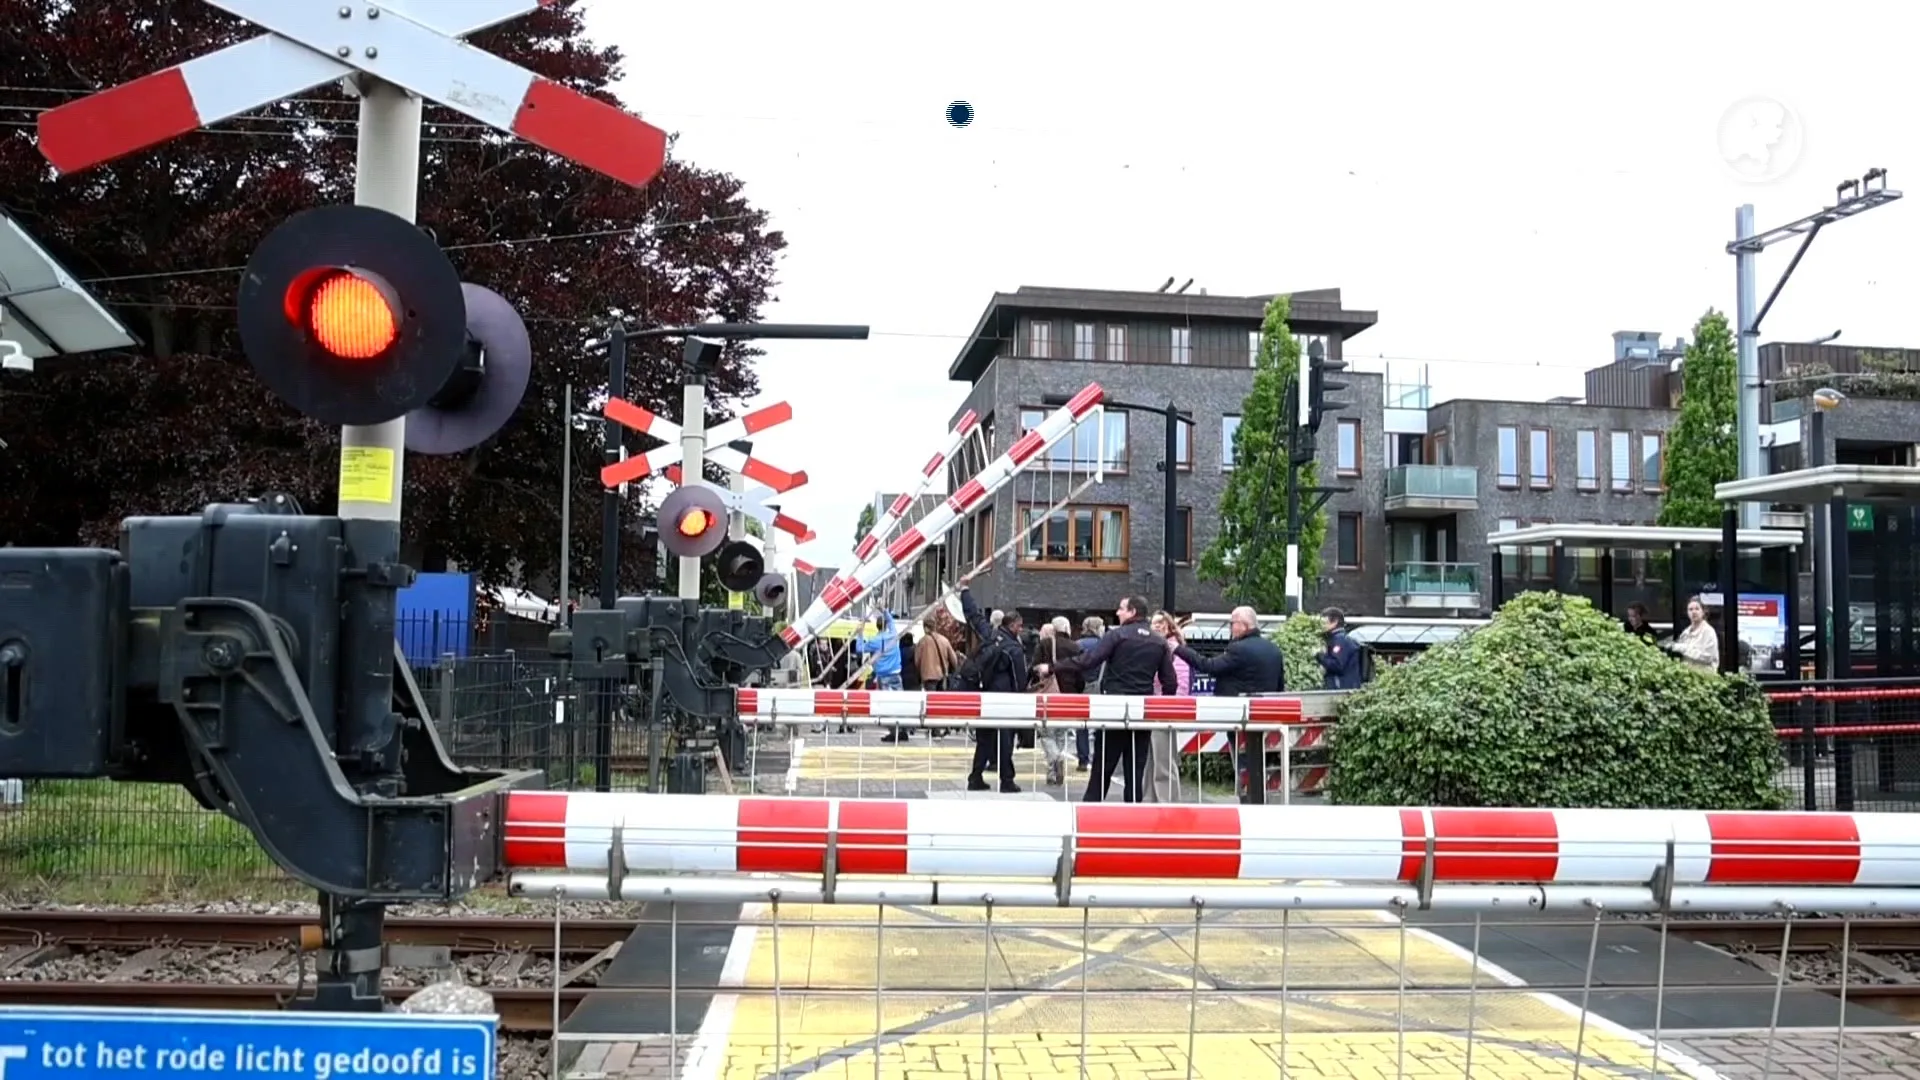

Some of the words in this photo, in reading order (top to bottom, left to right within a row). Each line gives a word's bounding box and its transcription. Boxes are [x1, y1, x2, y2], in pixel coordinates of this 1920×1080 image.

[42, 1041, 87, 1068] tot
[96, 1040, 147, 1069] het
[156, 1043, 226, 1071] rode
[235, 1043, 305, 1073] licht
[314, 1047, 441, 1080] gedoofd
[452, 1048, 477, 1076] is
